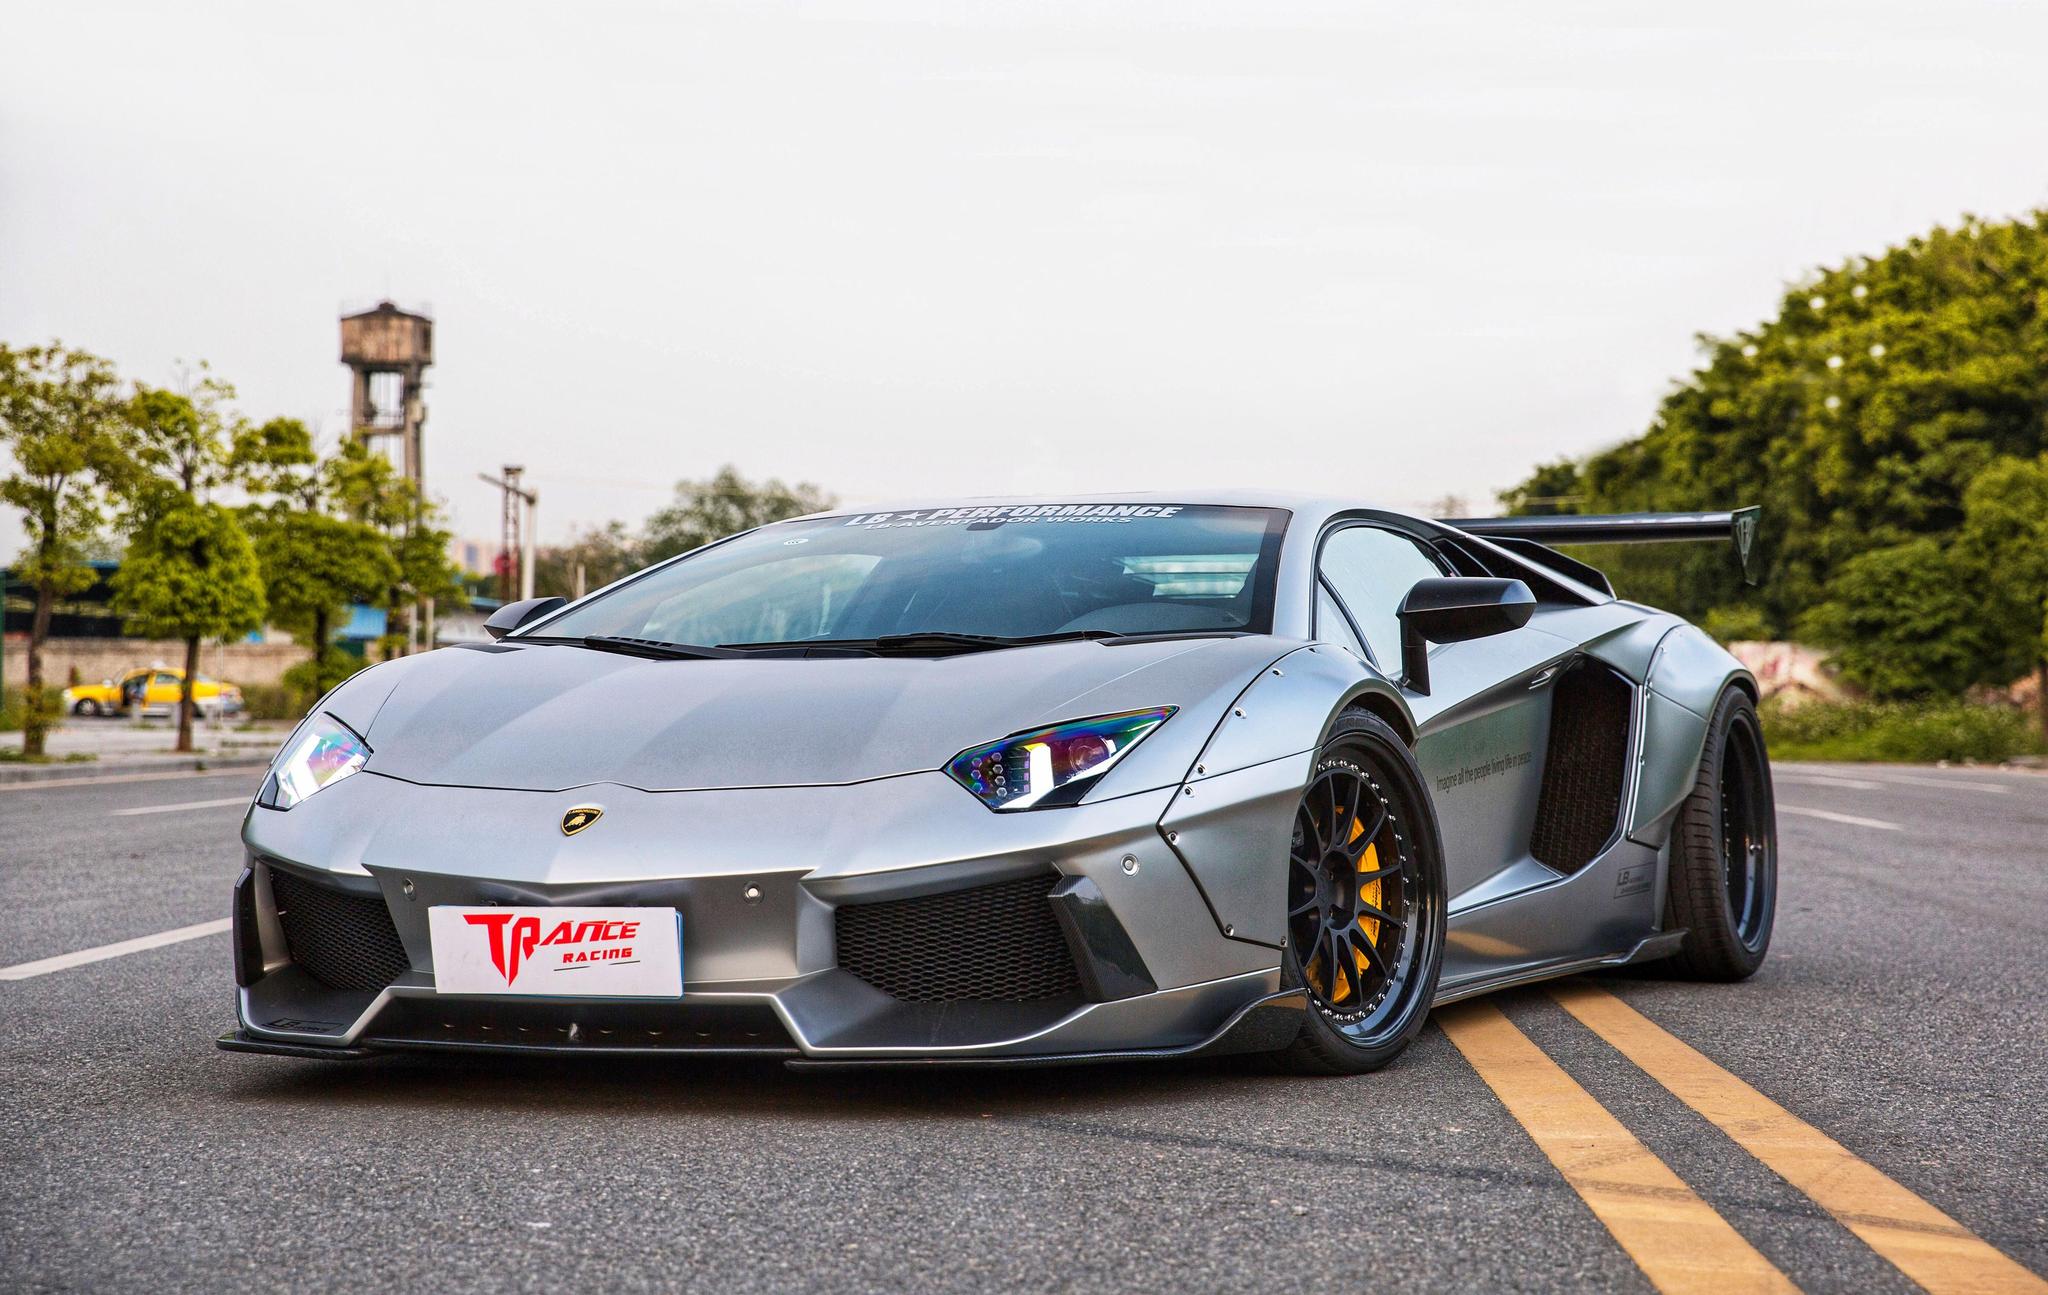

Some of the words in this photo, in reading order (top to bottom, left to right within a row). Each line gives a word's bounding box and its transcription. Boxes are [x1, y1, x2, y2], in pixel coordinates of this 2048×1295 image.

[844, 513, 894, 527] LB
[926, 505, 1184, 520] PERFORMANCE
[1436, 772, 1457, 794] Imagine
[1465, 766, 1473, 782] the
[1474, 761, 1491, 784] people
[1492, 756, 1505, 776] living
[463, 914, 640, 987] TRANCE
[563, 948, 632, 964] RACING
